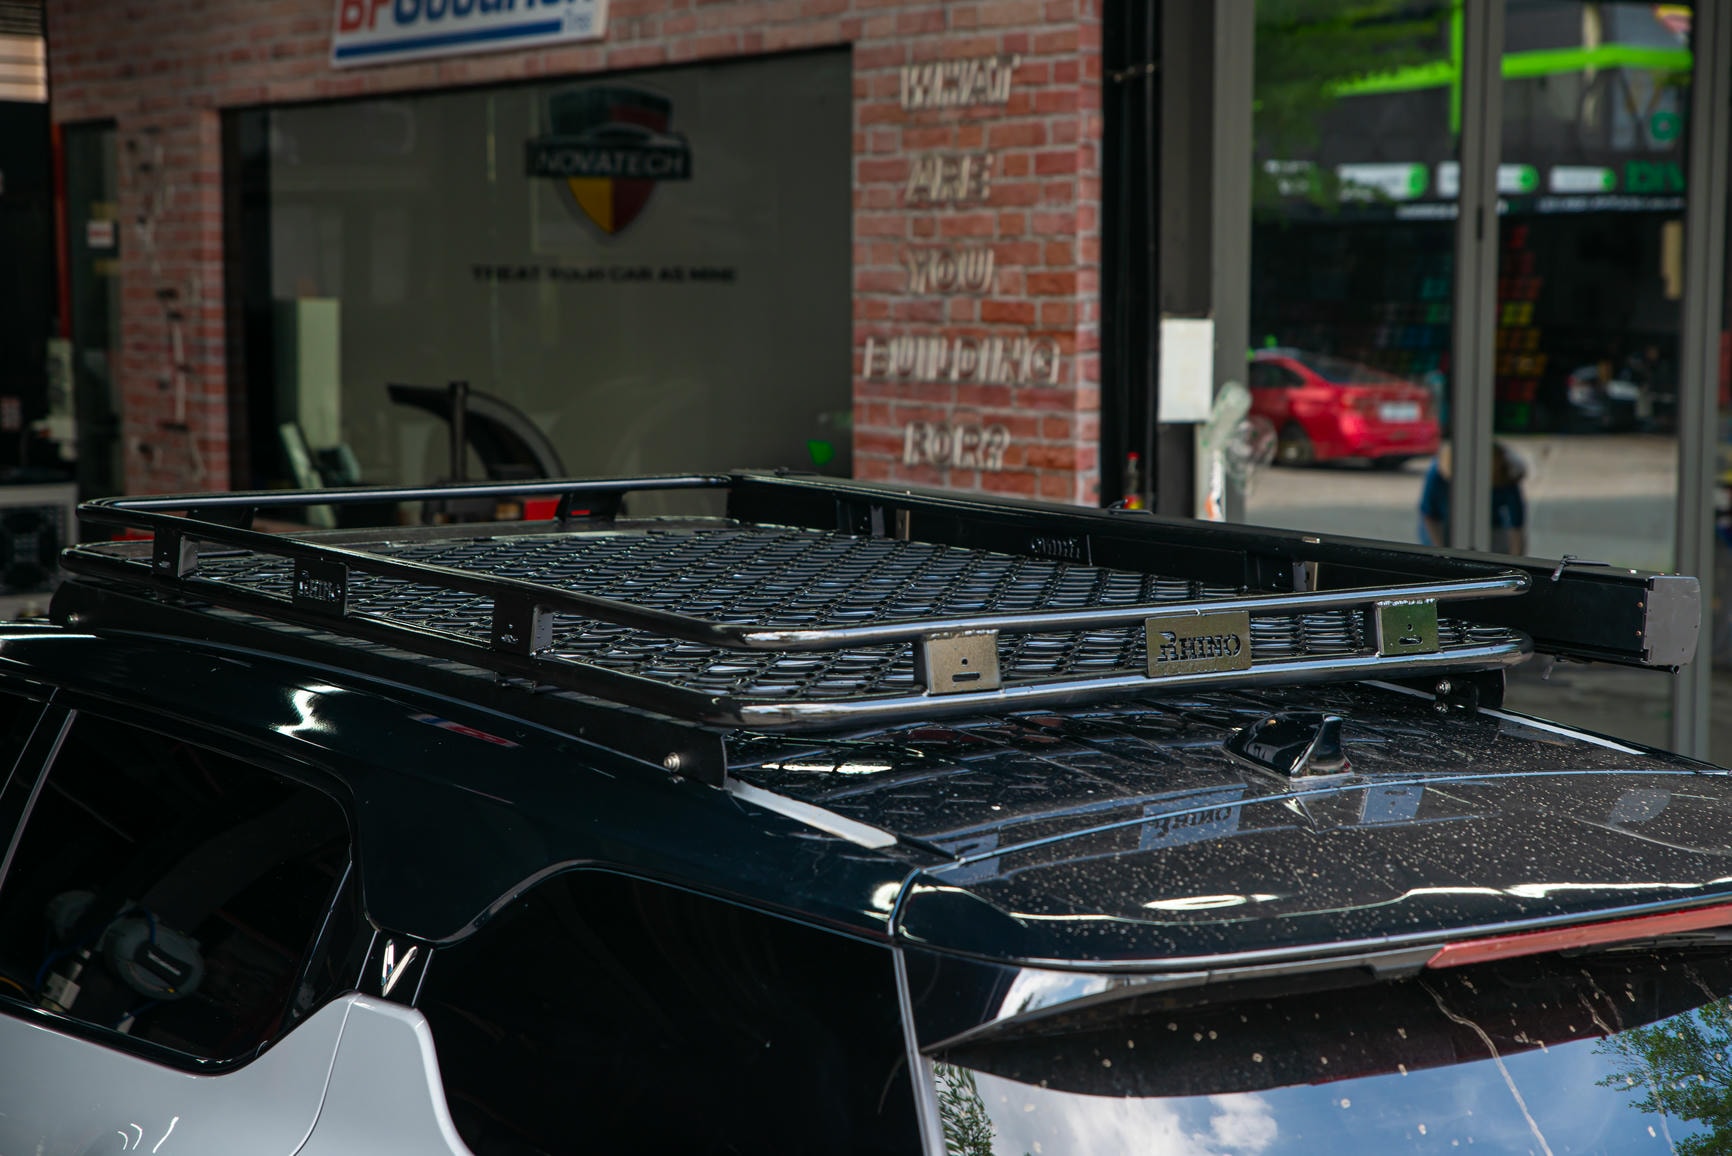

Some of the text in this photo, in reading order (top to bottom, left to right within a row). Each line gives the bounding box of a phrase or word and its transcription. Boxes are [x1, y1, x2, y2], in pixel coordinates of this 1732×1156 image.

[338, 0, 595, 33] BFGoo
[536, 149, 684, 175] NOVATECH
[906, 248, 995, 294] YOU
[1157, 630, 1241, 663] RHINO
